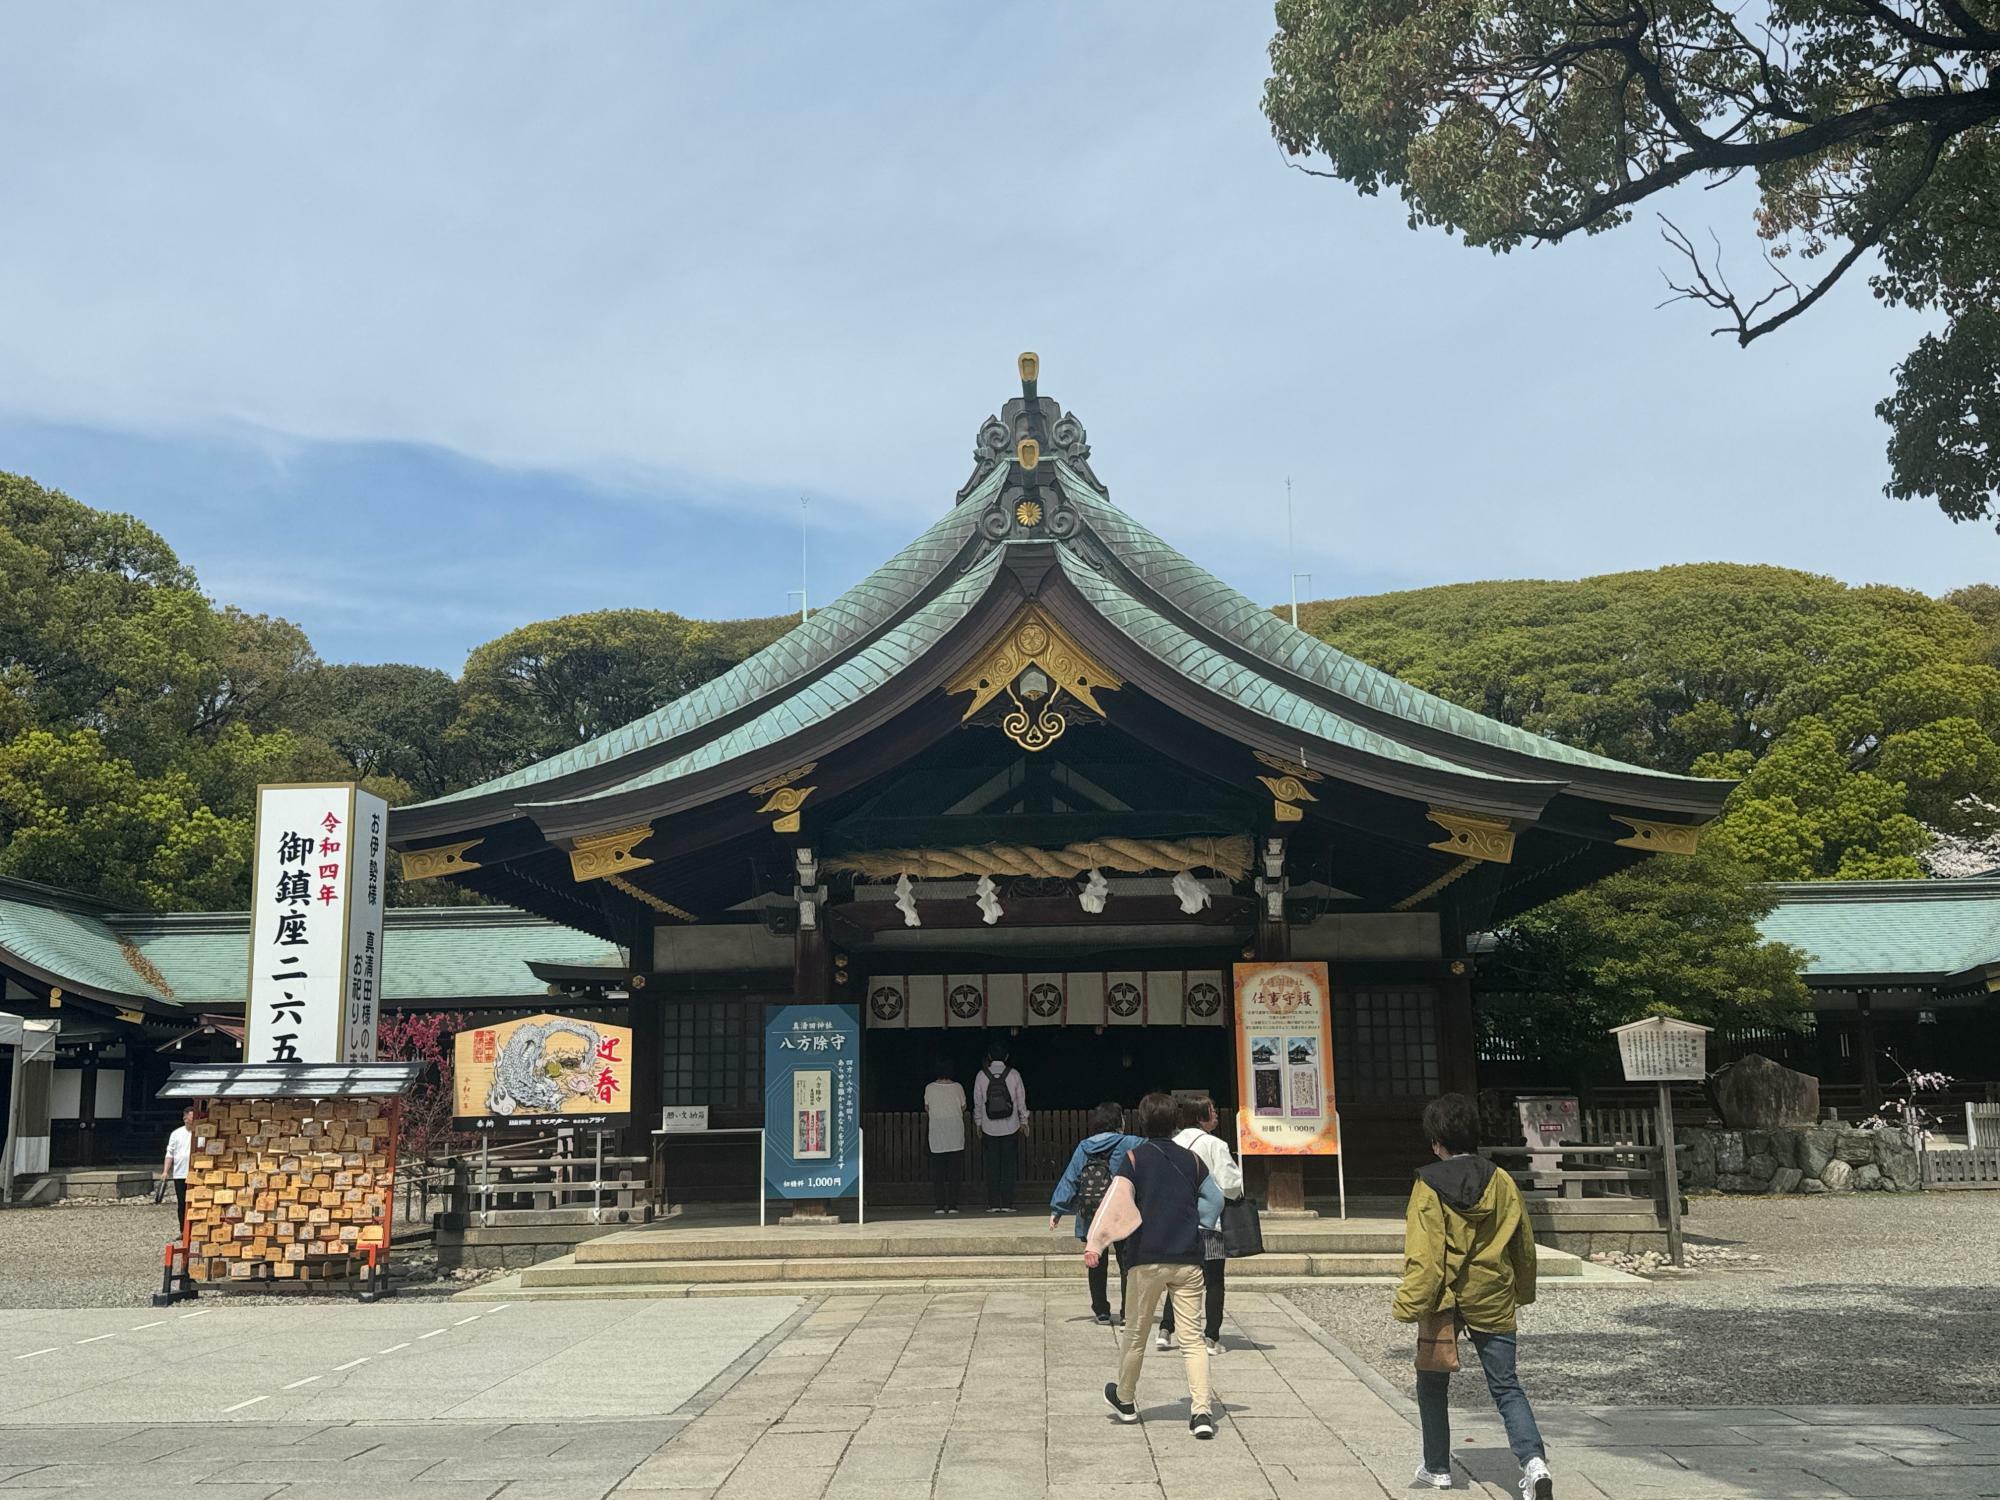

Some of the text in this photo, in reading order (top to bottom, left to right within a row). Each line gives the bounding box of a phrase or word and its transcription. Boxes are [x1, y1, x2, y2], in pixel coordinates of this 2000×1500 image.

[316, 811, 343, 906] 令和四年
[368, 813, 380, 905] お伊勢様
[266, 831, 315, 1063] 御鎮座二六五
[1251, 991, 1313, 1007] 仕事守護
[594, 1036, 623, 1104] 迎春
[780, 1034, 846, 1051] 八方除守
[807, 1177, 841, 1188] 1,000円
